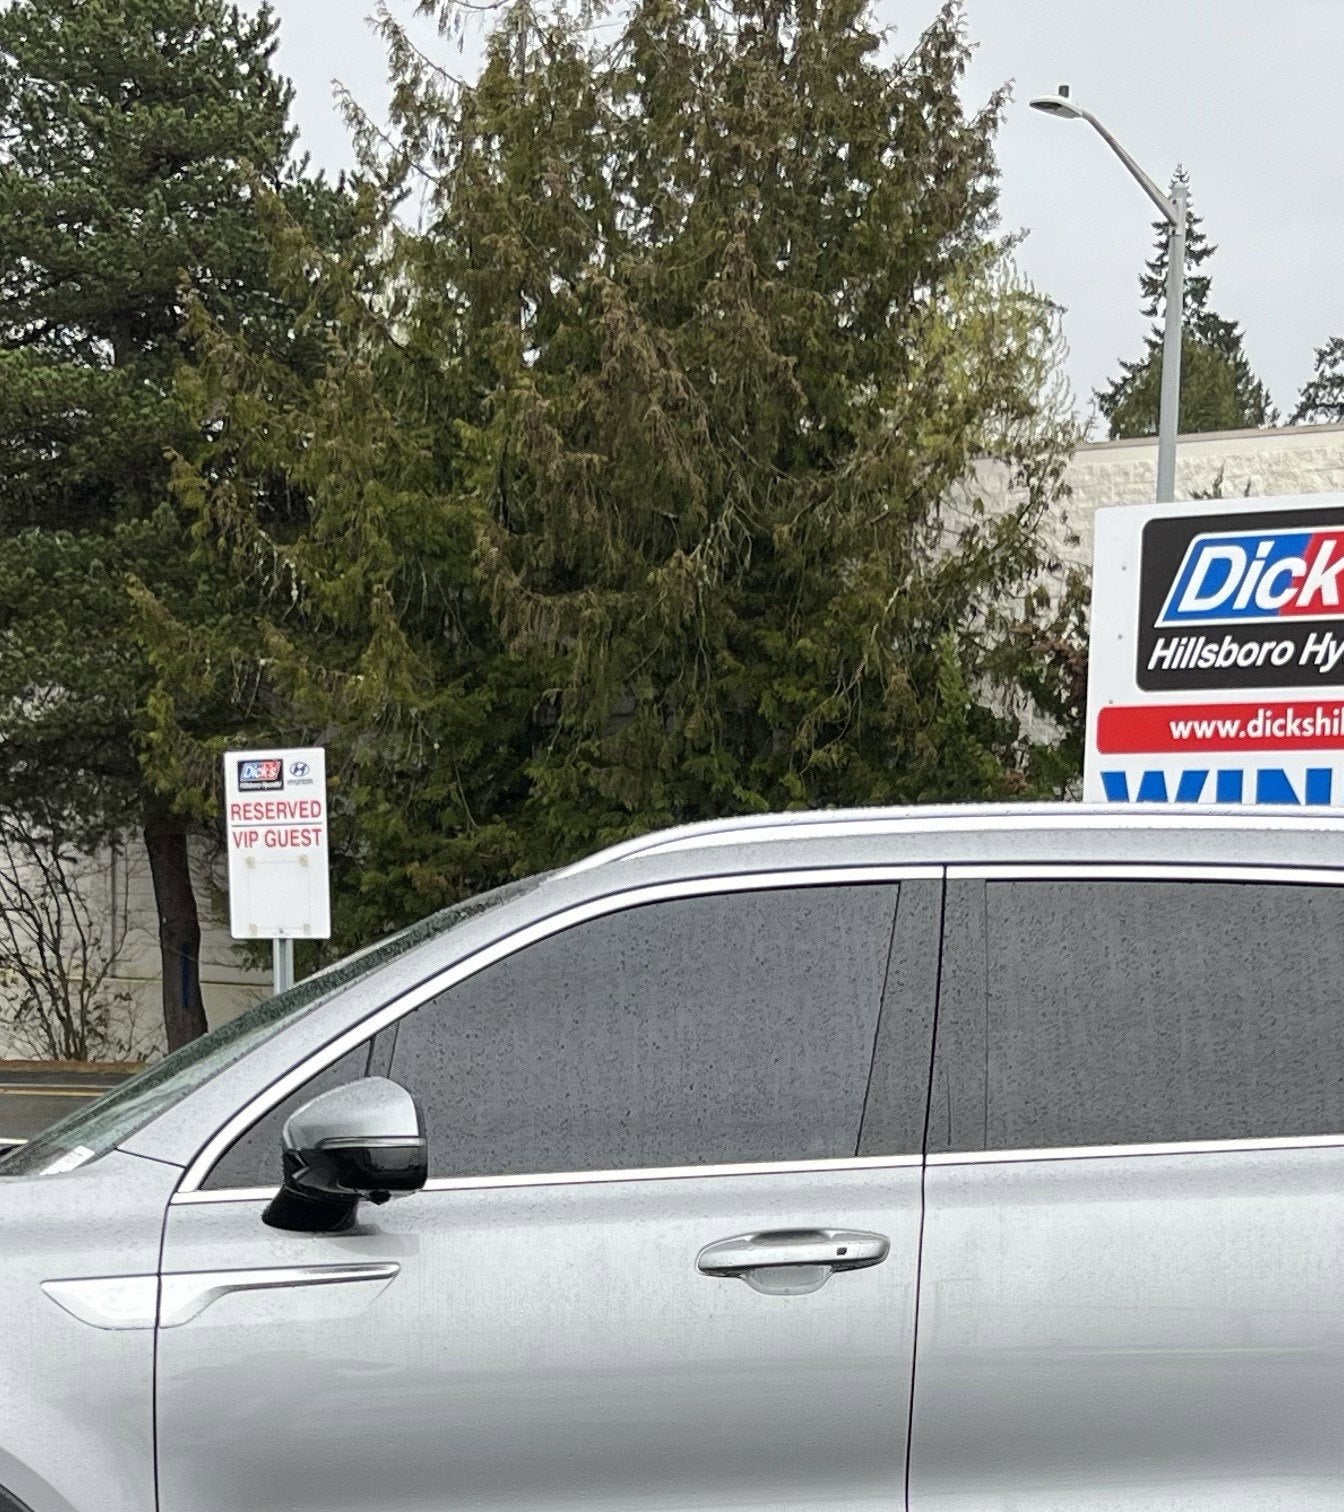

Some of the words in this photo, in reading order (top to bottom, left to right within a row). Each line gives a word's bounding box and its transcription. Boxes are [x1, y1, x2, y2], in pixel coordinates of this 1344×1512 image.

[1147, 634, 1296, 671] Hillsboro
[231, 801, 322, 821] RESERVED
[232, 830, 259, 849] VIP
[264, 828, 322, 848] GUEST
